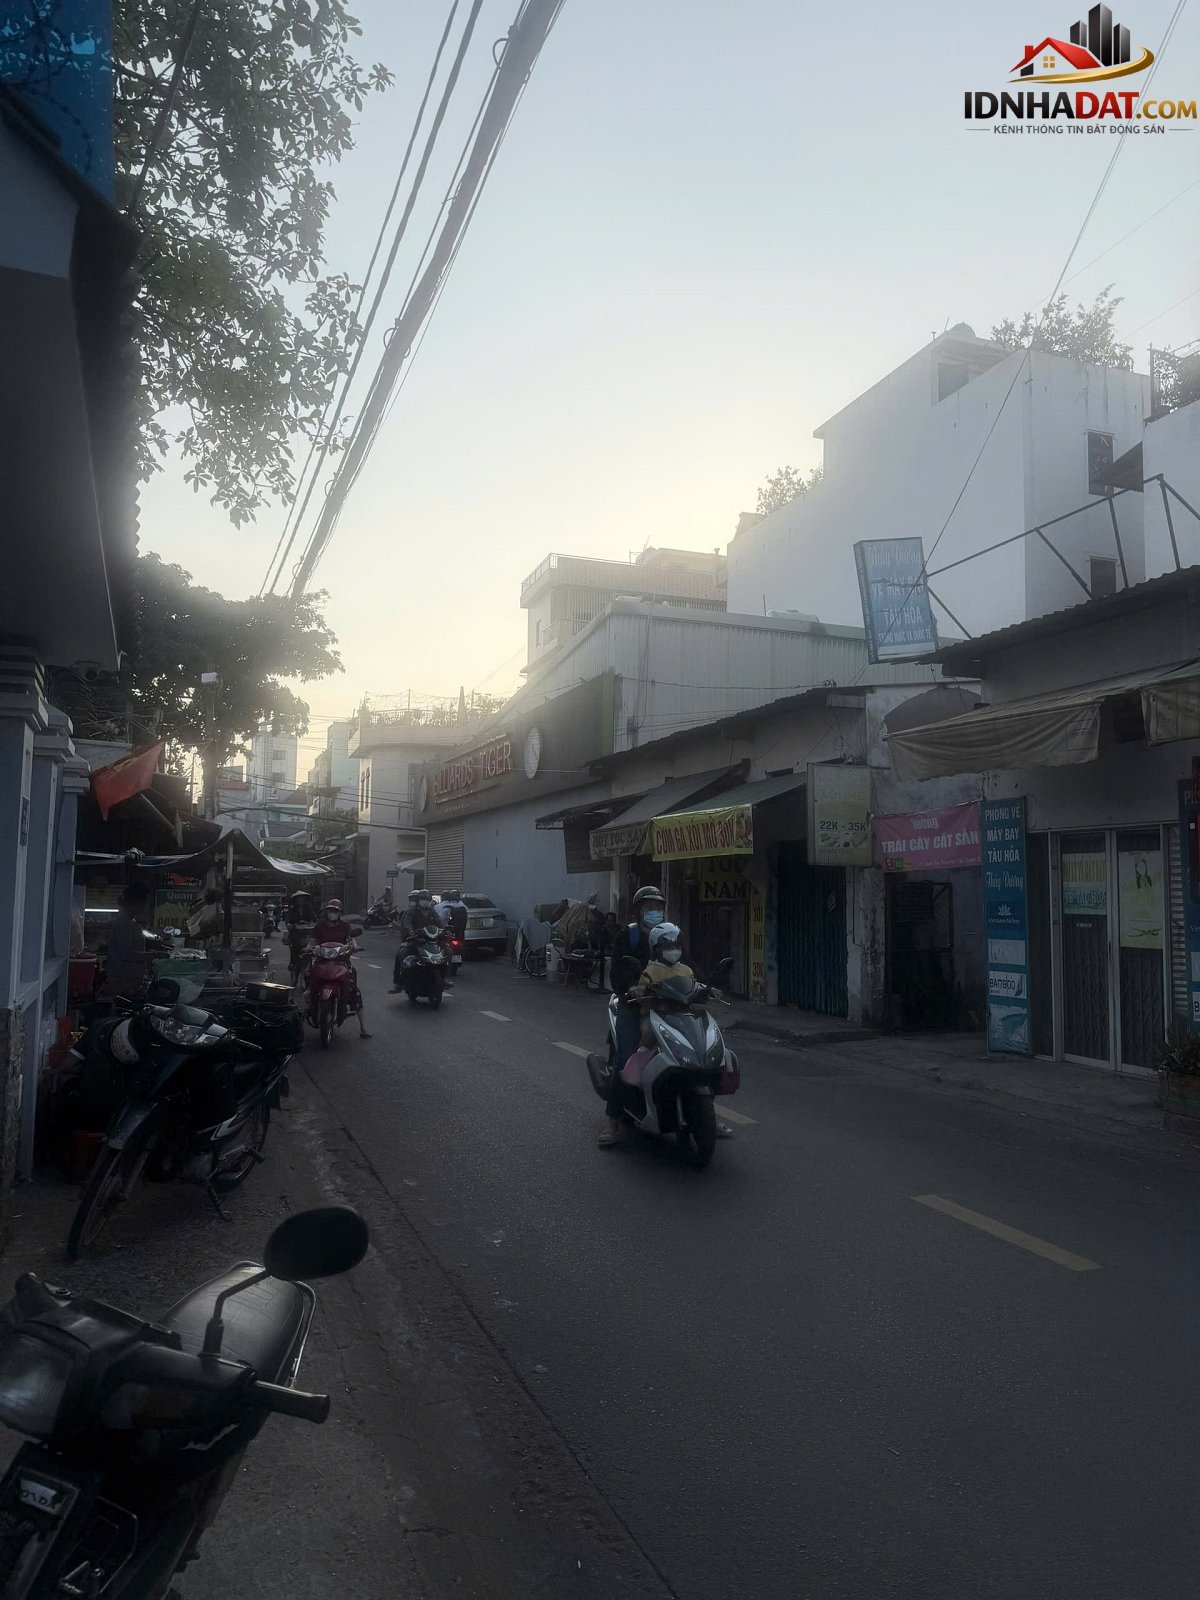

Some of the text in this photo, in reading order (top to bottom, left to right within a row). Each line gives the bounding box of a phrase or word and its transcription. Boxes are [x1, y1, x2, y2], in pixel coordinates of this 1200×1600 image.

[480, 741, 511, 780] TIGER
[820, 820, 839, 831] 22K
[848, 821, 868, 833] 35K
[1004, 827, 1020, 841] BAY
[704, 881, 748, 898] NAM
